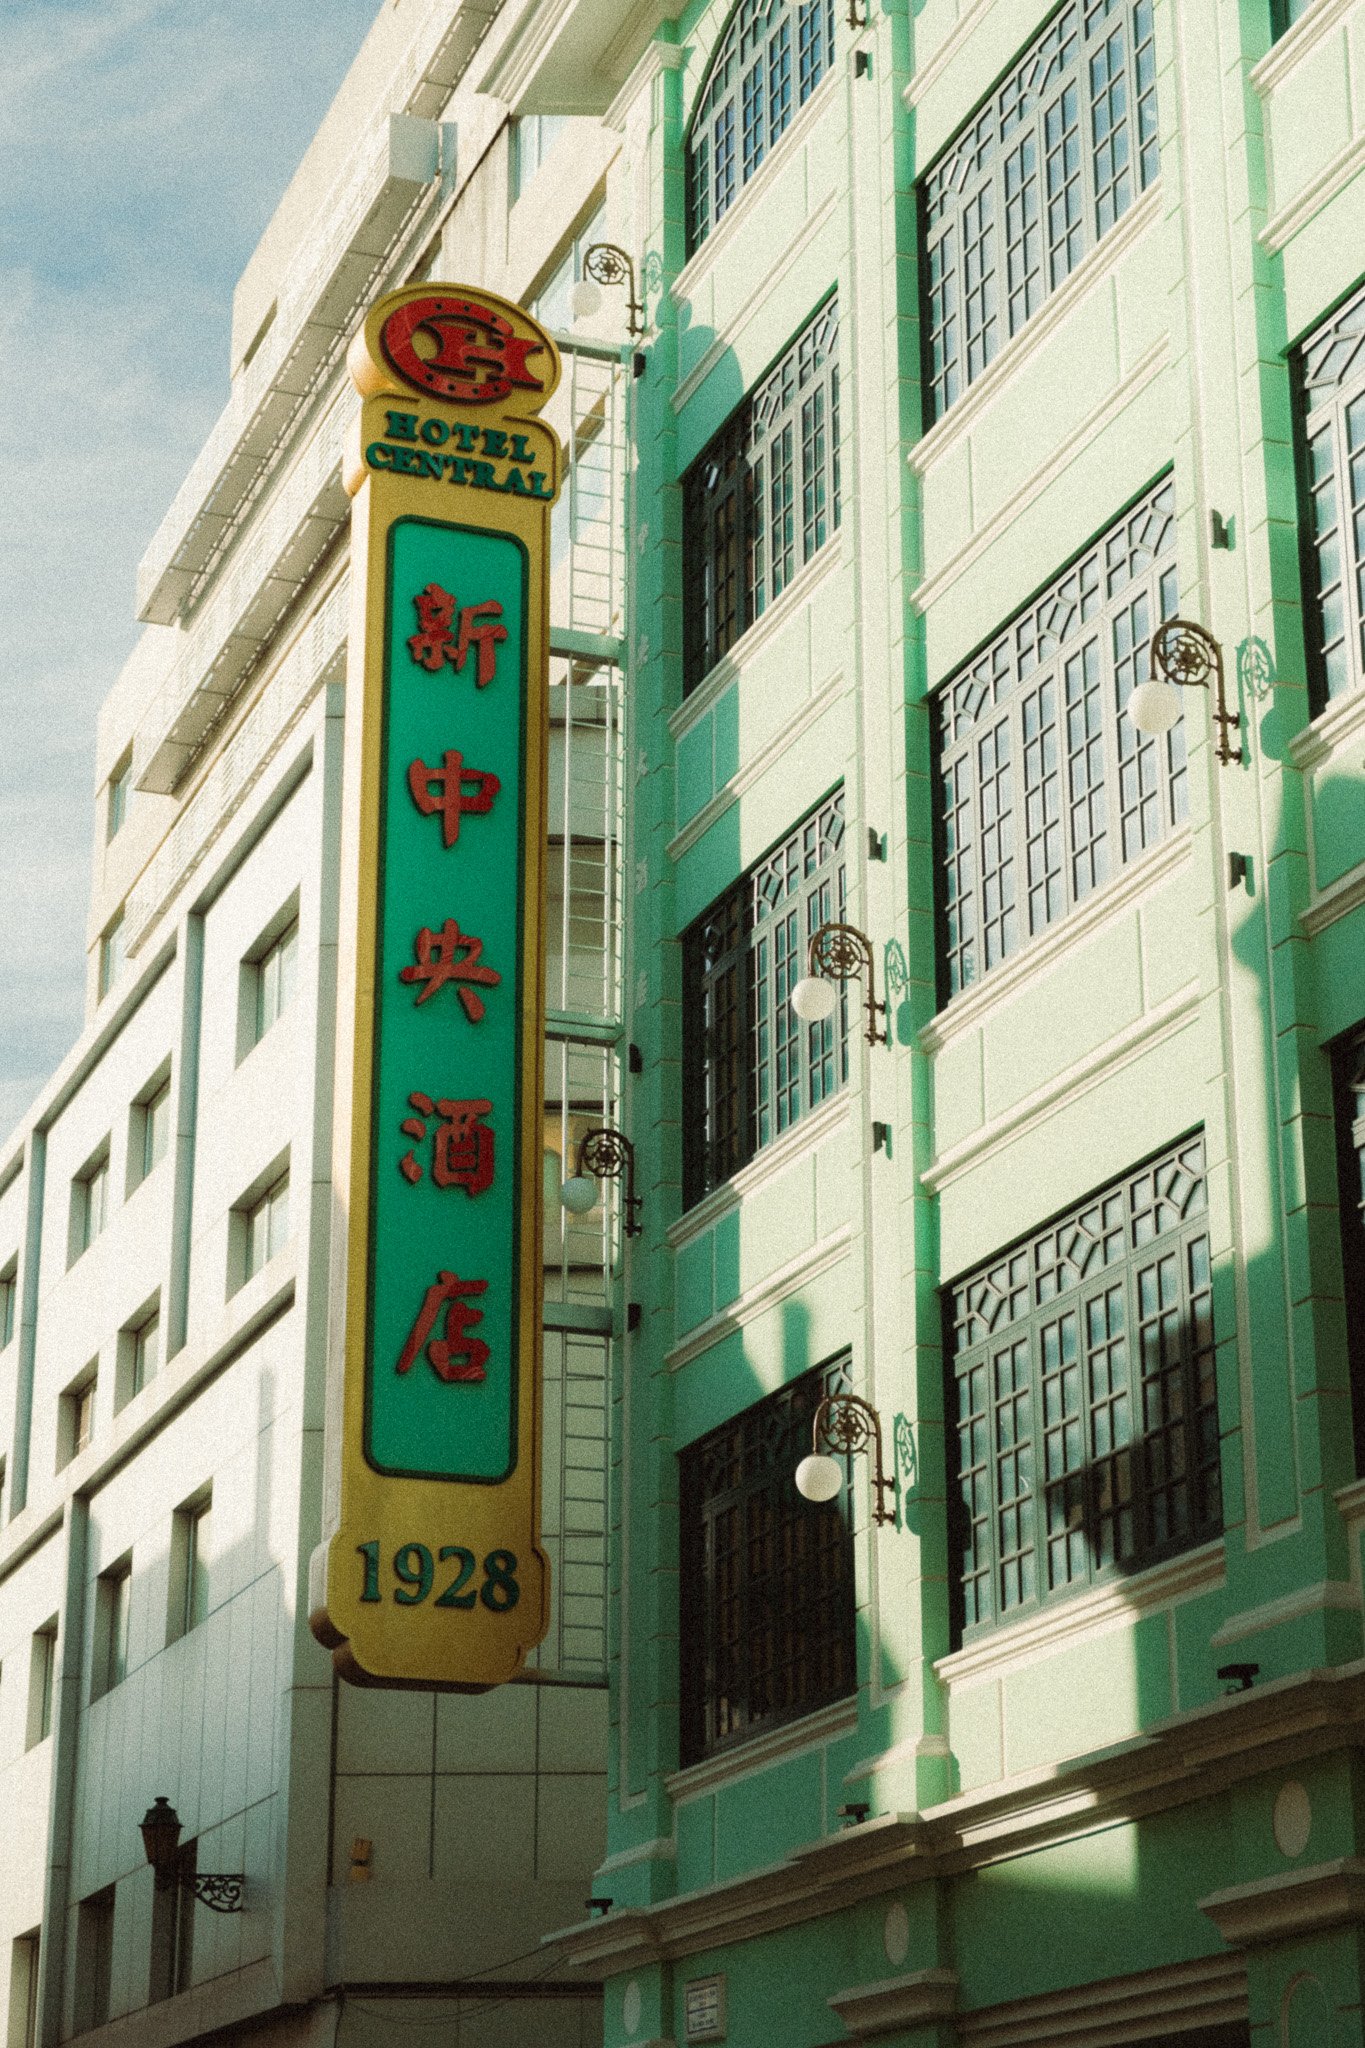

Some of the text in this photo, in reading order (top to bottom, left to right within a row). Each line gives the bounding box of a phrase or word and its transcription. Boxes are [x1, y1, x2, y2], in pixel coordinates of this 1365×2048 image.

[385, 410, 536, 464] HOTEL
[365, 442, 555, 500] CENTRAL
[397, 582, 508, 1381] 新中央酒店
[356, 1540, 520, 1612] 1928
